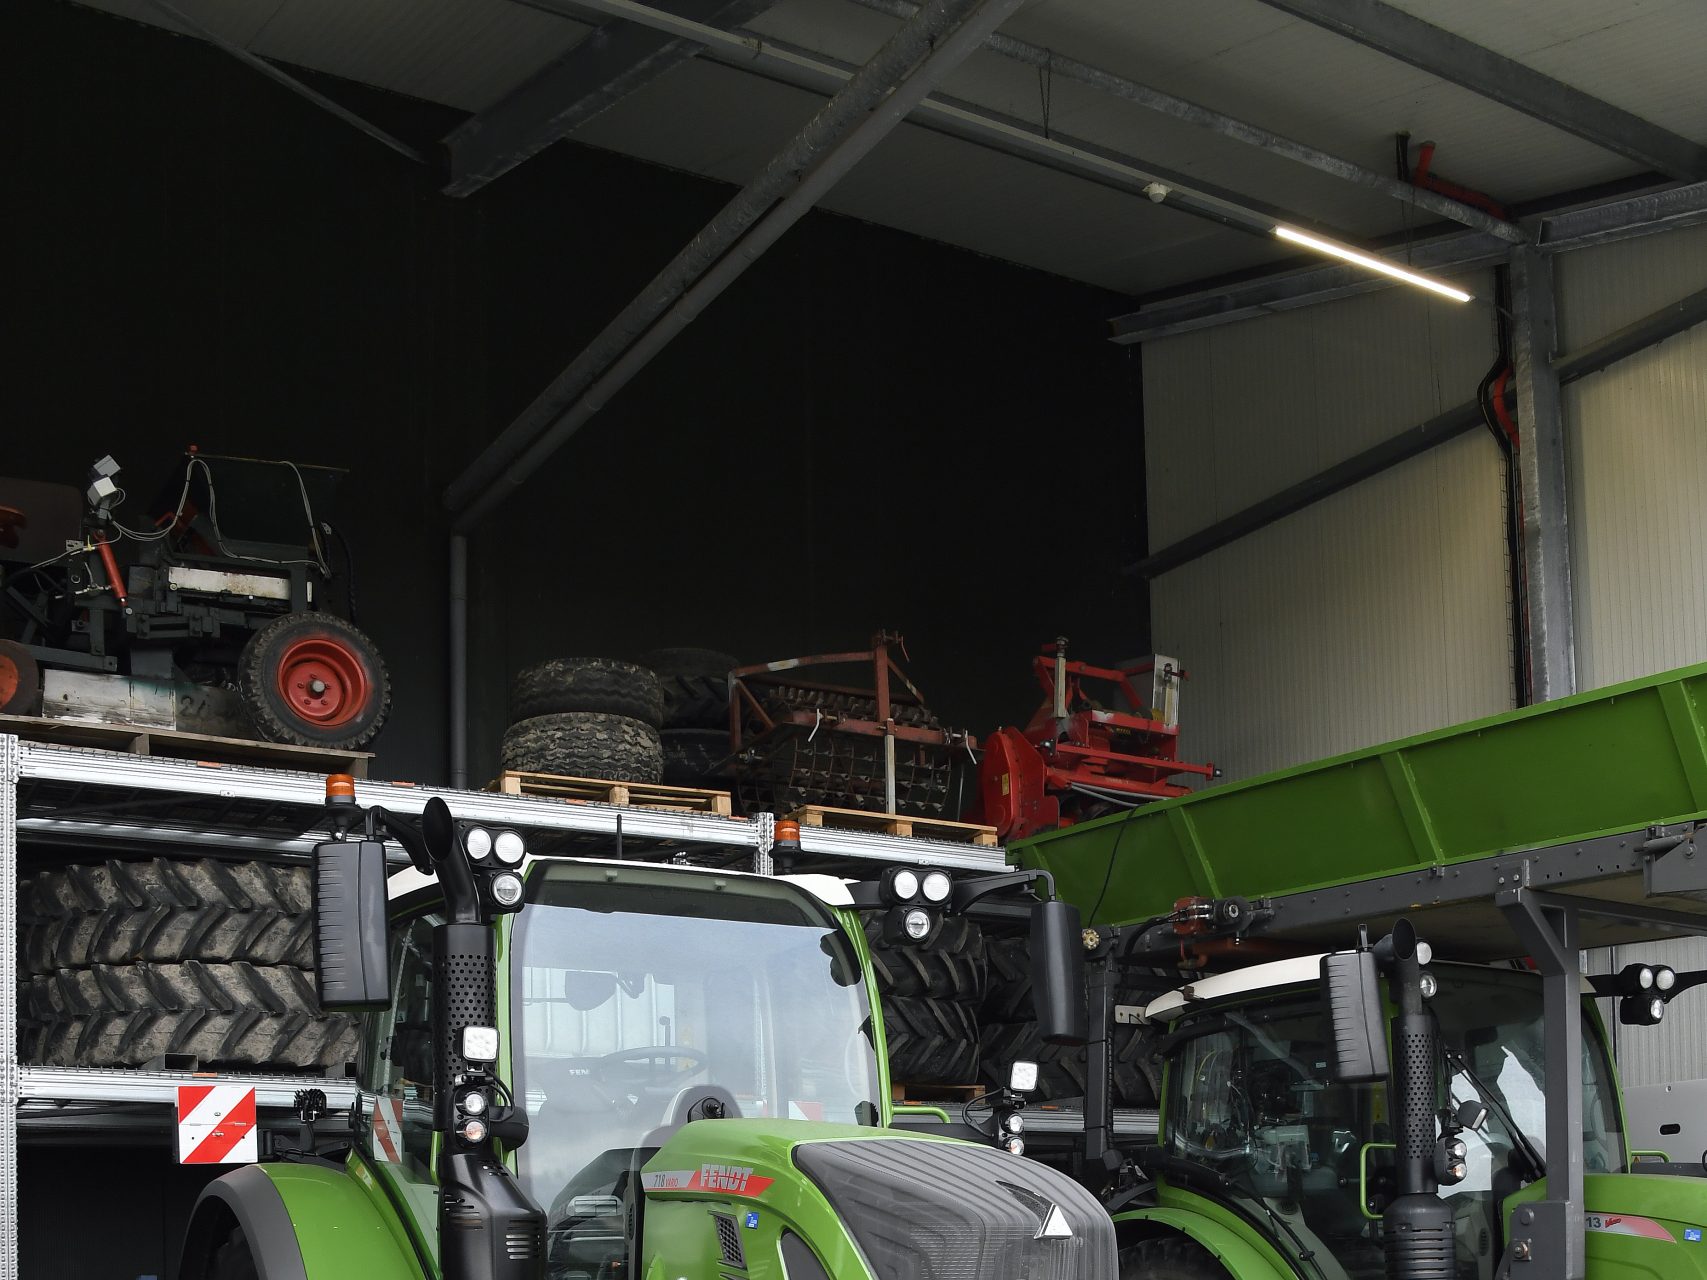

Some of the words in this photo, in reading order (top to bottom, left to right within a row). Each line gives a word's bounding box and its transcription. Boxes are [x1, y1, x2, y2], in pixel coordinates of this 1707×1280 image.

[654, 1174, 665, 1187] 718
[700, 1163, 754, 1192] FENDT
[1585, 1216, 1602, 1228] 13
